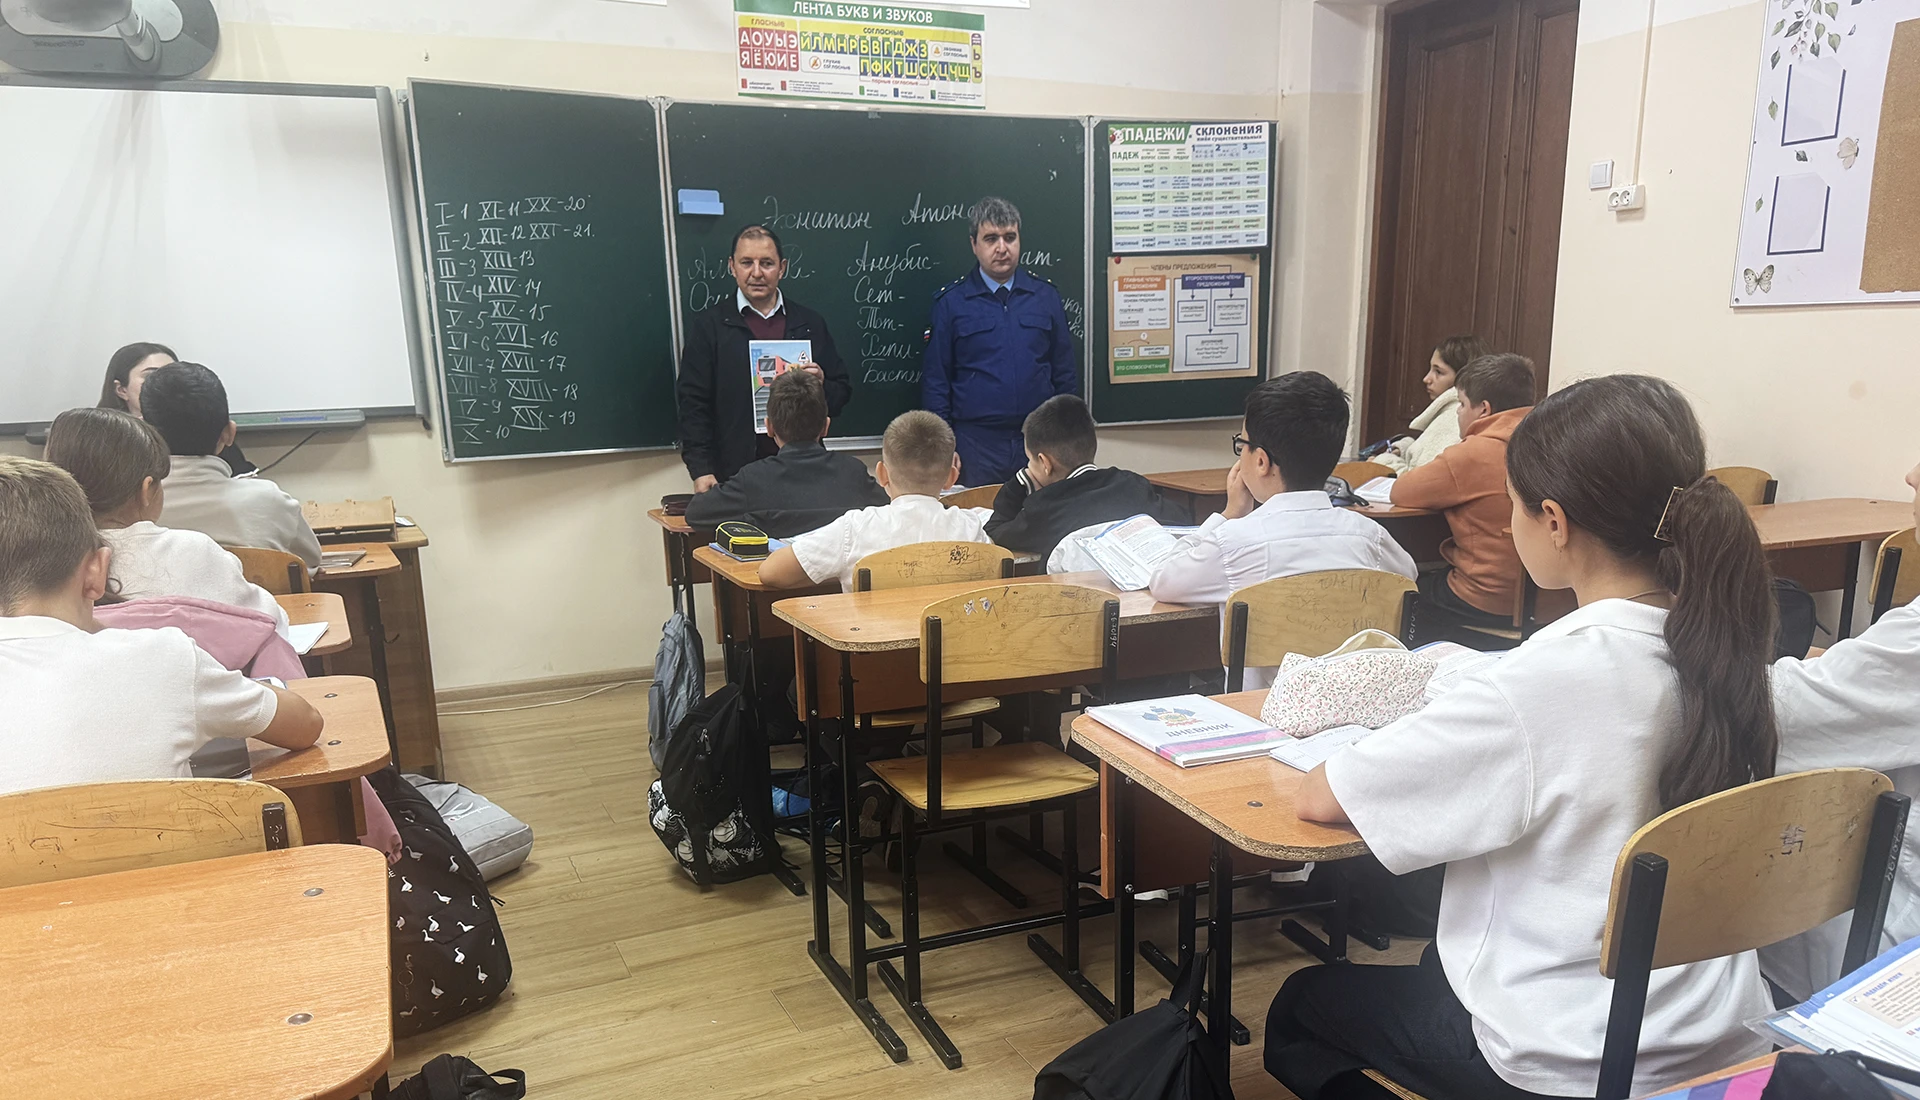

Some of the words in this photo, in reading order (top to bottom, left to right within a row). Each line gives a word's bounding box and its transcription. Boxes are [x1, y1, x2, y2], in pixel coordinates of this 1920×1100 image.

[793, 1, 833, 16] ЛЕНТА
[837, 5, 869, 18] БУКВ
[873, 8, 882, 19] И
[885, 9, 933, 23] ЗВУКОВ
[1125, 127, 1185, 143] ПАДЕЖИ
[1191, 144, 1196, 152] 1
[1112, 151, 1140, 161] ПАДЕЖ
[1165, 723, 1235, 738] ДНЕВНИК
